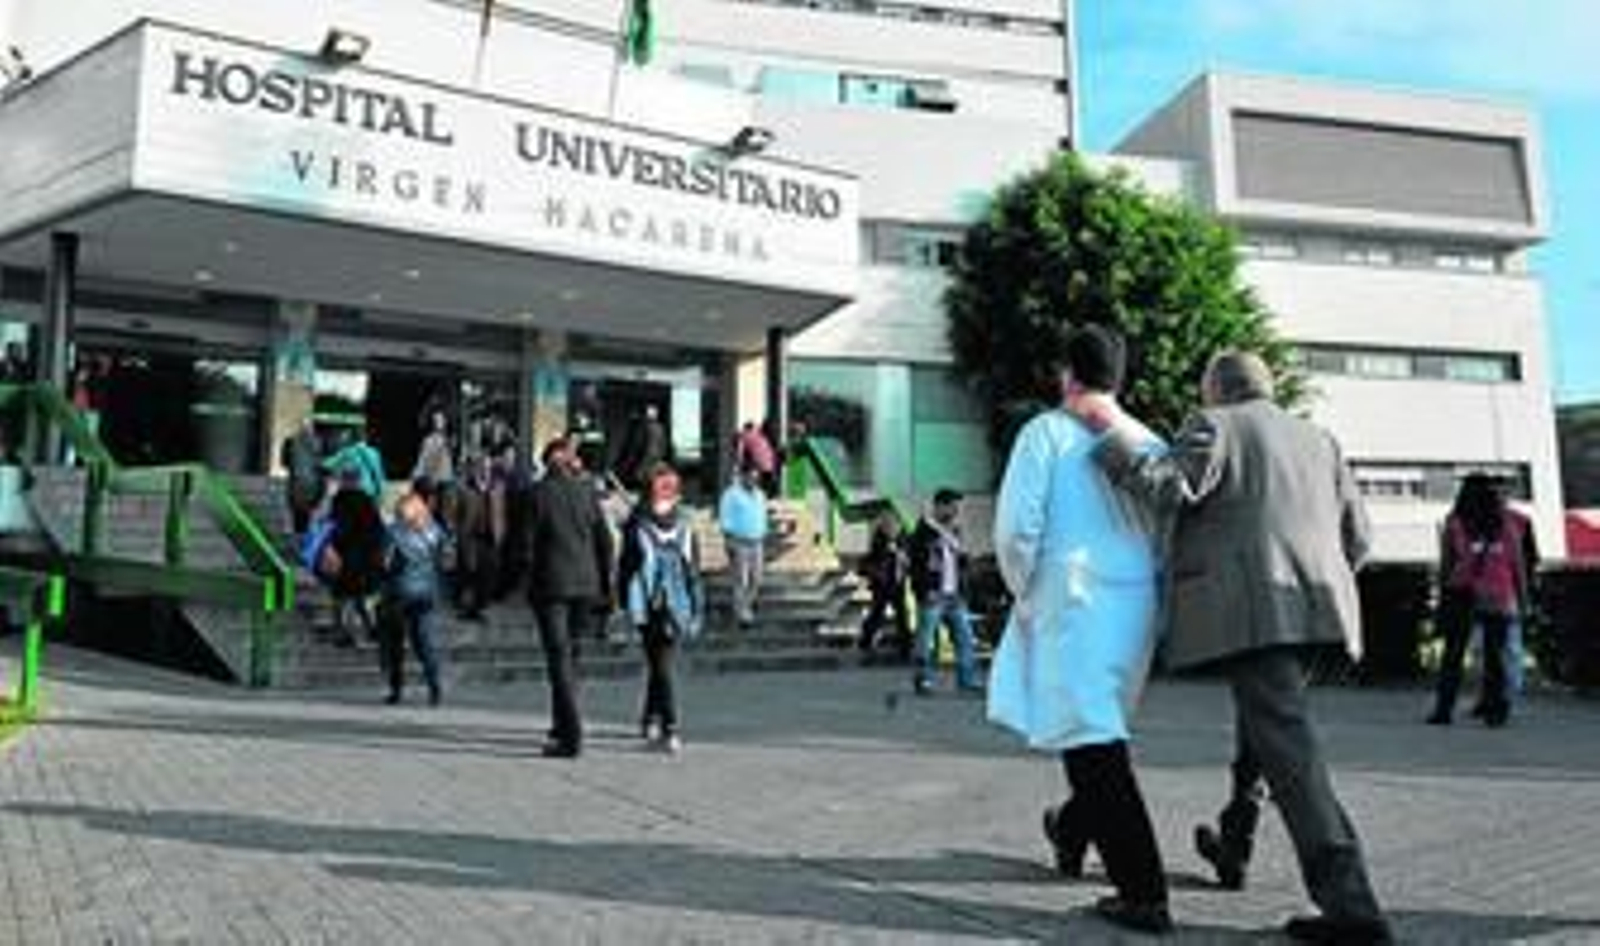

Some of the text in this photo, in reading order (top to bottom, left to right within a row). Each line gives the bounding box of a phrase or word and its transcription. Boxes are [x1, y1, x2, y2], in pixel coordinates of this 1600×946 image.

[171, 53, 842, 220] HOSPITAL UNIVERSITARIO
[290, 150, 486, 214] VIRGEN
